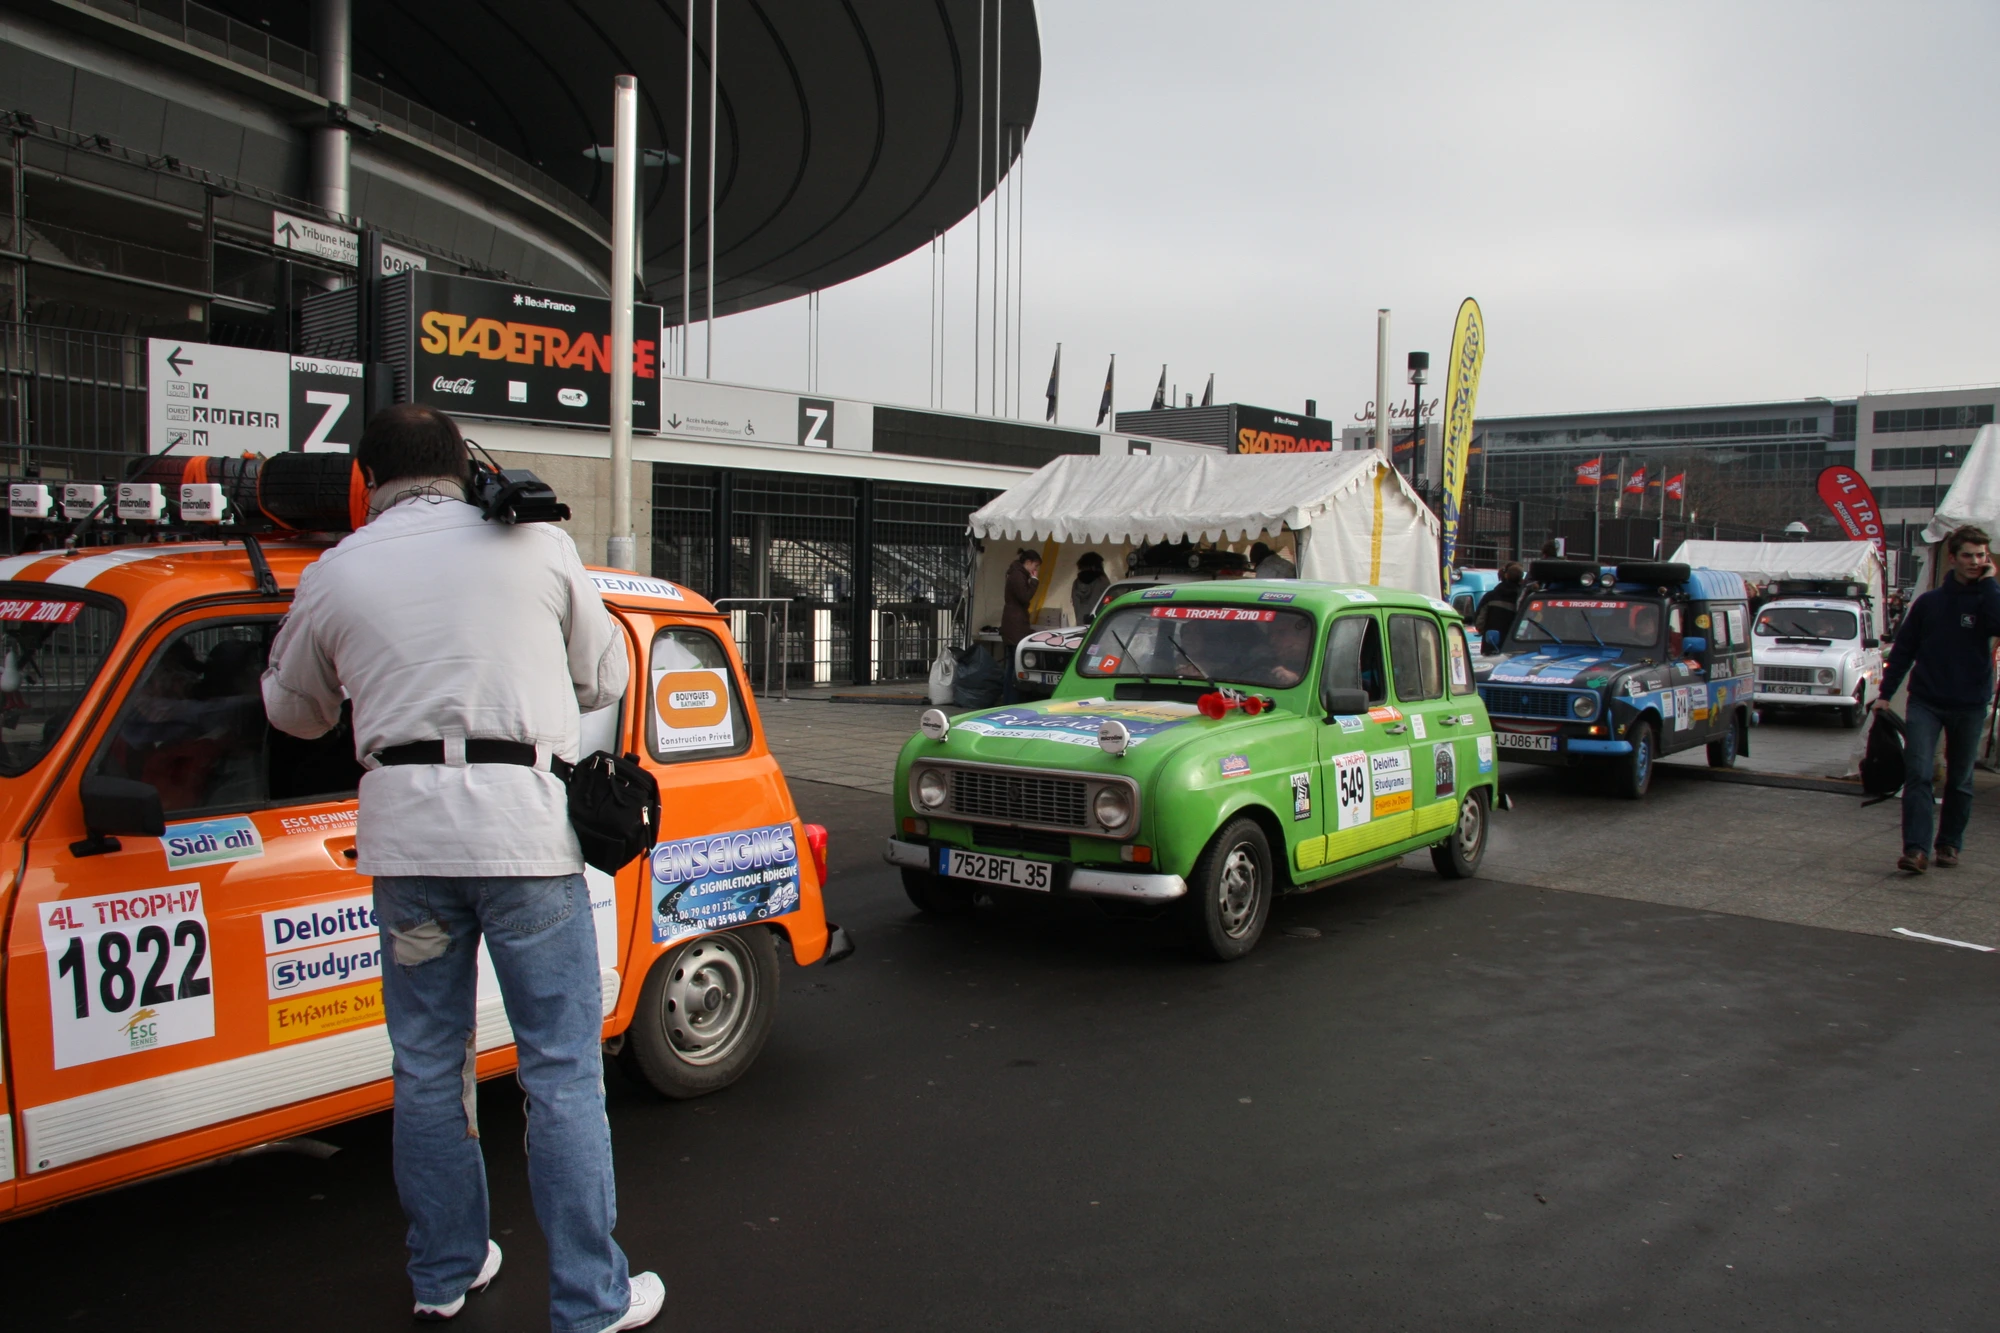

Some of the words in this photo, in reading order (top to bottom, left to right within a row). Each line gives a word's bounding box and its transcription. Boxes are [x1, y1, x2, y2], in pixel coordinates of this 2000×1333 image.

[301, 225, 337, 245] Tribune
[315, 242, 340, 258] Upper
[420, 311, 654, 378] STADEFRANE
[195, 386, 207, 399] Y
[168, 407, 189, 415] OUEST
[303, 390, 350, 454] Z
[804, 408, 828, 448] Z
[195, 433, 207, 446] N
[1836, 473, 1857, 494] 4L
[119, 498, 151, 508] microline
[182, 499, 211, 509] microline
[31, 602, 67, 621] 2010
[1165, 608, 1178, 618] 4L
[1185, 609, 1230, 619] TROPHY
[1234, 610, 1260, 621] 2010
[1104, 658, 1115, 669] P
[675, 691, 709, 701] BOUYGUES
[660, 733, 707, 746] Construction
[1100, 734, 1123, 742] microline
[1373, 756, 1399, 771] Deloitte
[1341, 766, 1364, 807] 549
[281, 817, 309, 829] ESC
[285, 825, 317, 835] SCHOOL
[168, 834, 218, 857] Sidi
[224, 829, 255, 849] ali
[652, 826, 796, 884] ENSEIGNES
[954, 853, 986, 878] 752
[988, 858, 1021, 884] BFL
[1024, 863, 1048, 888] 35
[689, 885, 698, 897] &
[700, 873, 762, 896] SIGNALETIQUE
[762, 864, 798, 883] ADHESIVE
[48, 906, 84, 930] 4L
[92, 889, 199, 925] TROPHY
[658, 913, 673, 924] Port
[679, 910, 689, 920] 06
[691, 907, 700, 917] 79
[701, 905, 710, 915] 42
[712, 903, 720, 913] 91
[722, 901, 731, 911] 31
[671, 926, 678, 935] &
[697, 919, 706, 930] 01
[708, 917, 717, 927] 49
[718, 915, 727, 925] 35
[728, 913, 737, 923] 98
[738, 910, 747, 920] 68
[58, 919, 211, 1019] 1822
[277, 999, 348, 1028] Enfants
[353, 994, 375, 1012] du
[130, 1022, 158, 1040] ESC
[130, 1036, 158, 1047] RENNES
